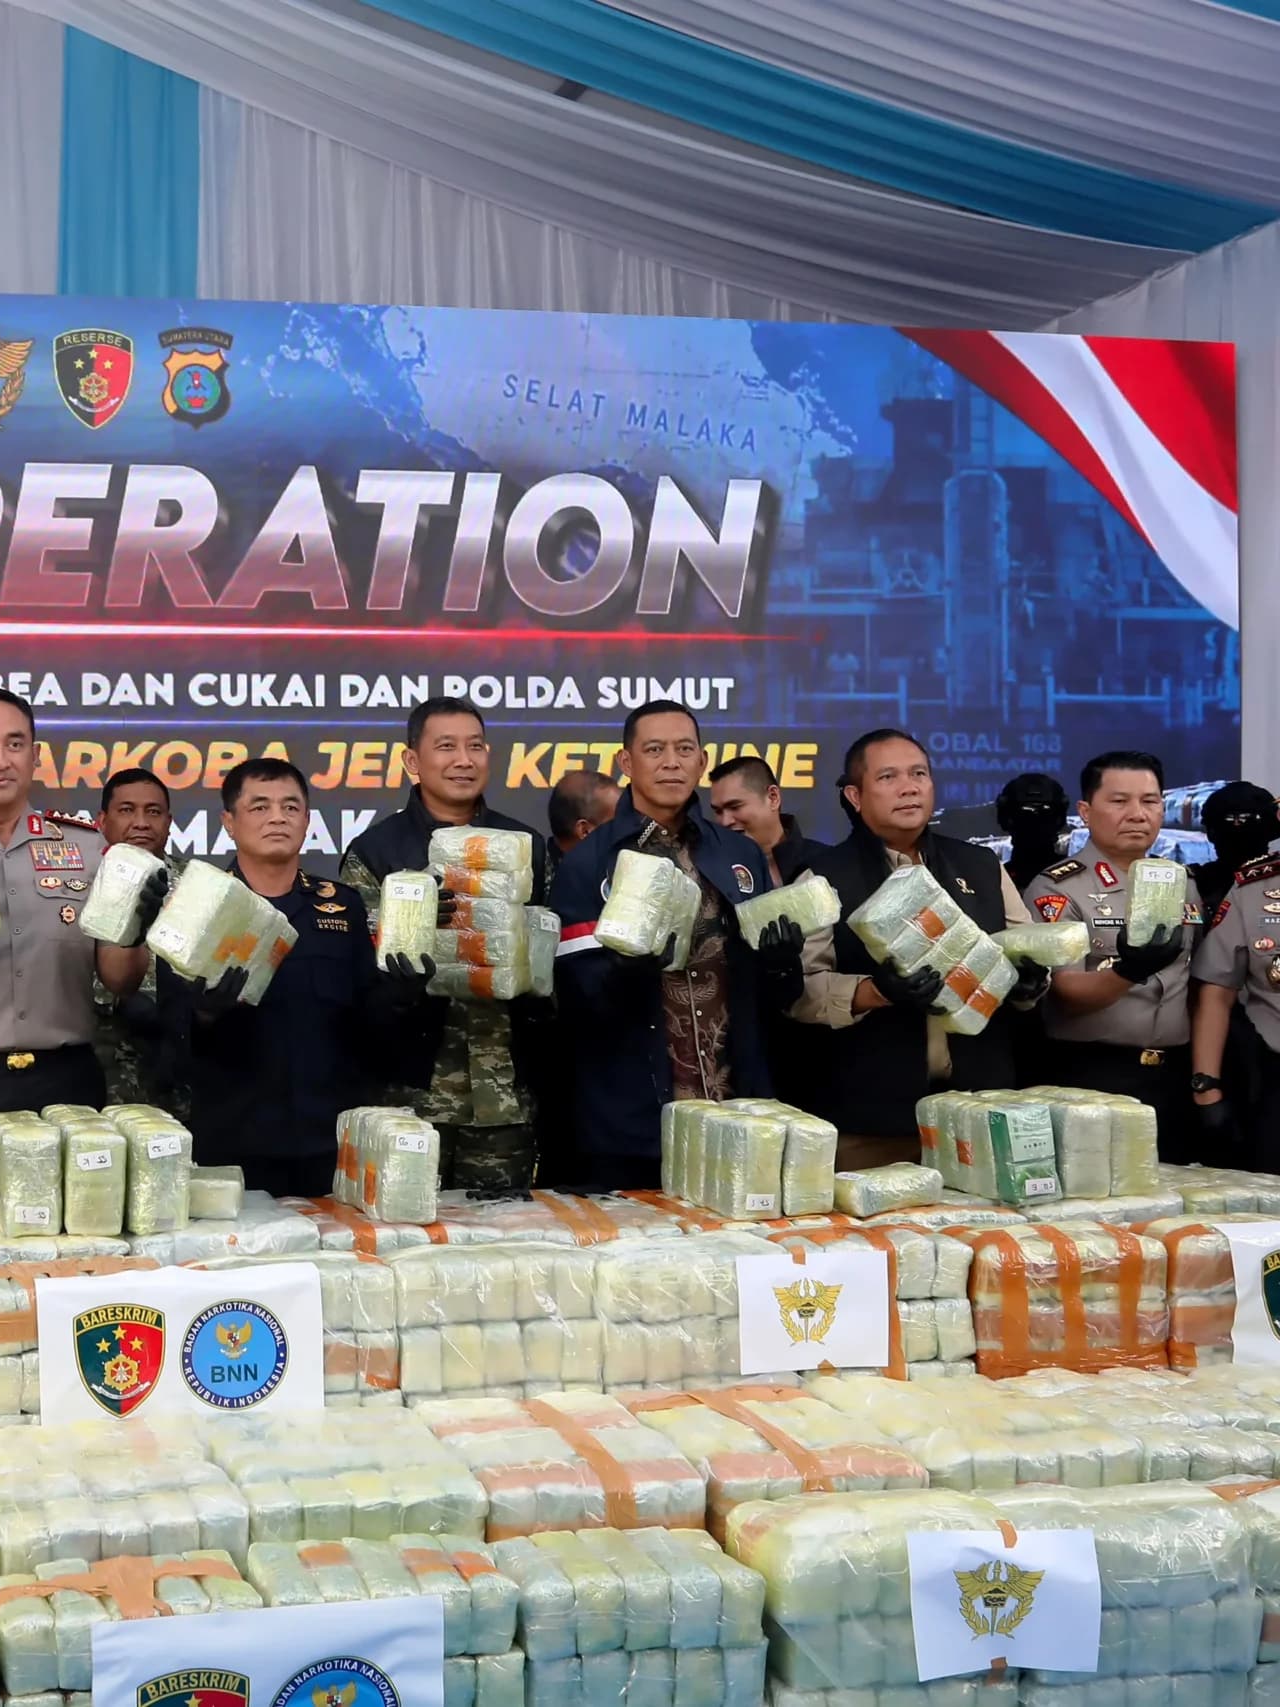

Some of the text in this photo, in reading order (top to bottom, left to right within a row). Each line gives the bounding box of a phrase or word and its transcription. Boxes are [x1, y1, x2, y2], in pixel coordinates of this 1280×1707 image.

[62, 332, 123, 345] RESERSE
[502, 373, 757, 452] SELAT MALAKA
[81, 672, 175, 706] DAN
[188, 673, 326, 708] CUKAI
[340, 674, 429, 708] DAN
[443, 675, 575, 710] POLDA
[597, 676, 735, 711] SUMUT
[80, 1307, 159, 1329] BARESKRIM
[183, 1302, 285, 1353] BADAN NARKOTIKA NASIONAL
[184, 1361, 285, 1407] REPUBLIK INDONESIA
[210, 1363, 258, 1384] BNN
[145, 1671, 241, 1700] BARESKRIM
[294, 1659, 359, 1686] NARKOTIKA
